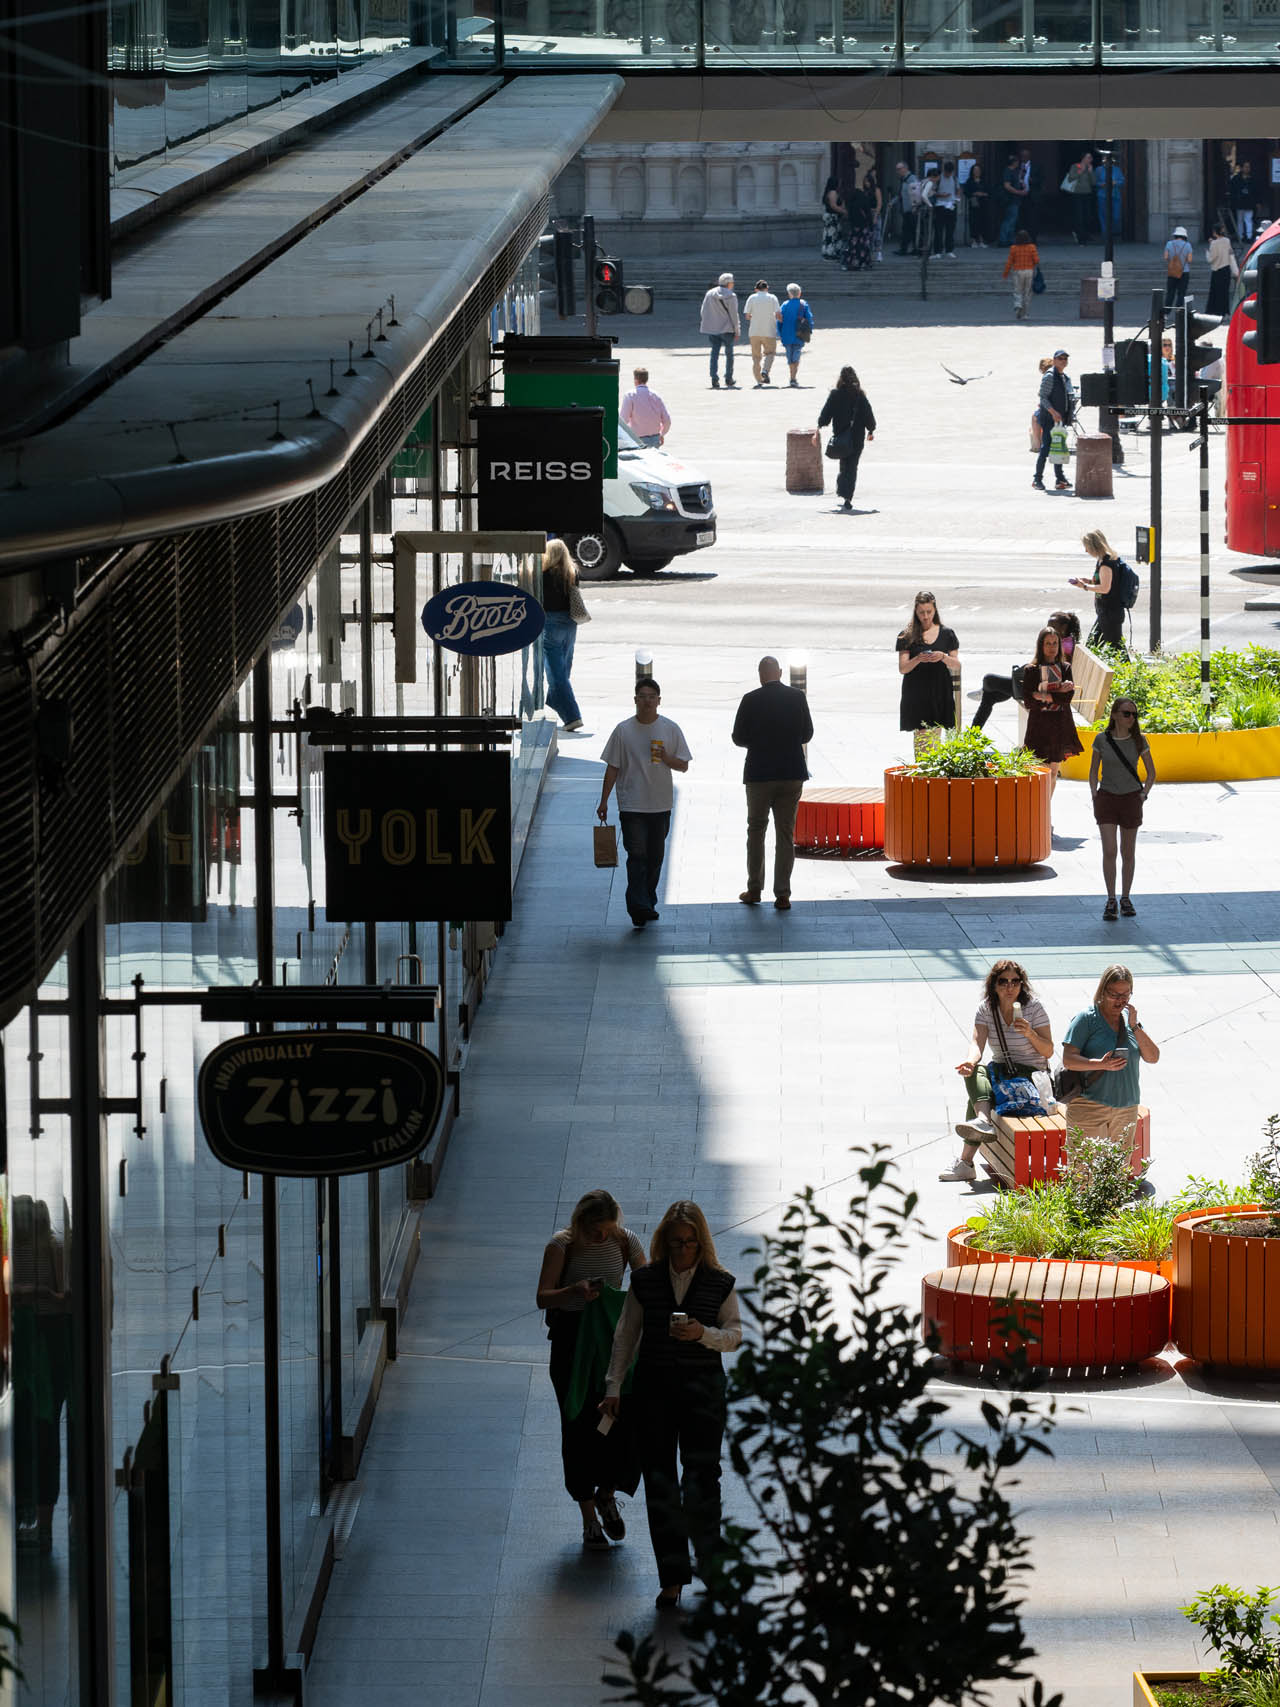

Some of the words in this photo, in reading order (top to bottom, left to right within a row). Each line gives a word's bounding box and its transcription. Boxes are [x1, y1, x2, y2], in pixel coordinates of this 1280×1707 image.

[489, 461, 592, 481] REISS
[434, 594, 528, 642] Boots
[336, 807, 498, 866] YOLK
[214, 1042, 315, 1091] INDIVIDUALLY
[242, 1076, 399, 1126] Zizzi
[370, 1109, 425, 1155] ITALIAN
